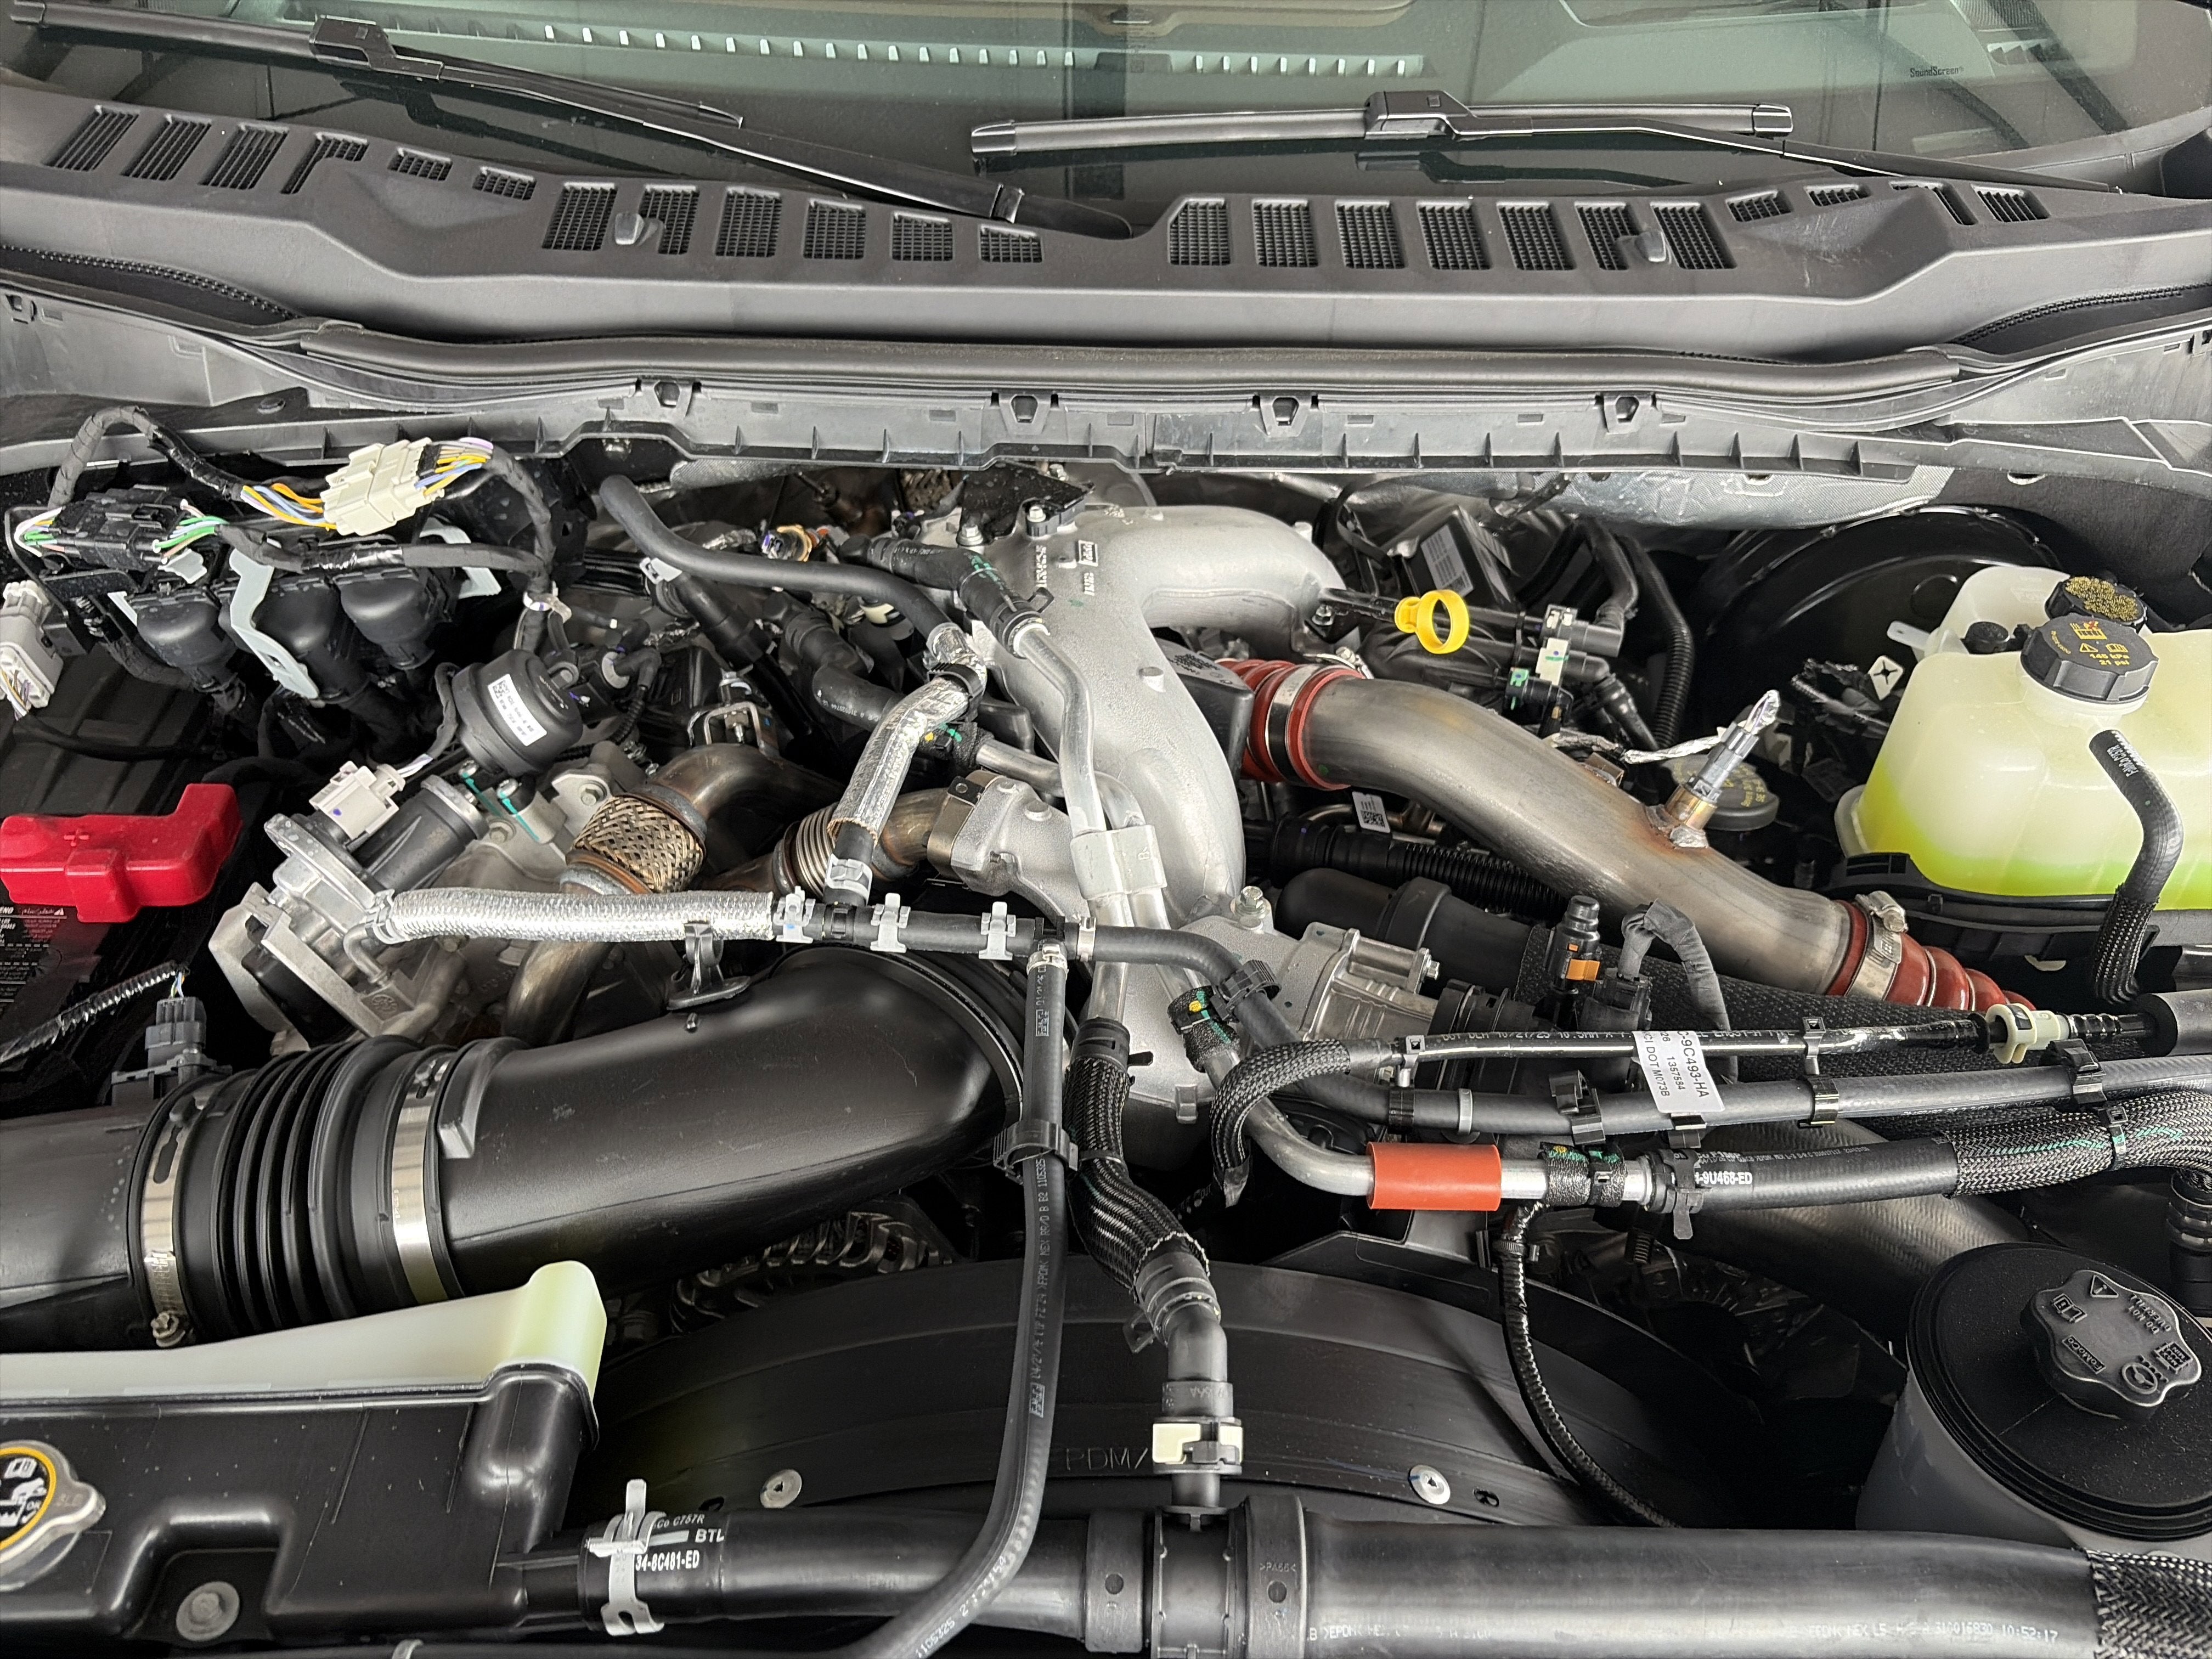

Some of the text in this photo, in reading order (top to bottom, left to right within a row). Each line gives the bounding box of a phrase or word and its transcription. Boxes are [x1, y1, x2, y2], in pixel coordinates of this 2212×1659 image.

[1646, 1046, 1660, 1070] DOT
[2129, 1305, 2160, 1335] DO NOT
[2067, 1338, 2103, 1372] FoMoCo
[695, 1528, 725, 1543] BTL
[2002, 1623, 2059, 1644] 10:52:17
